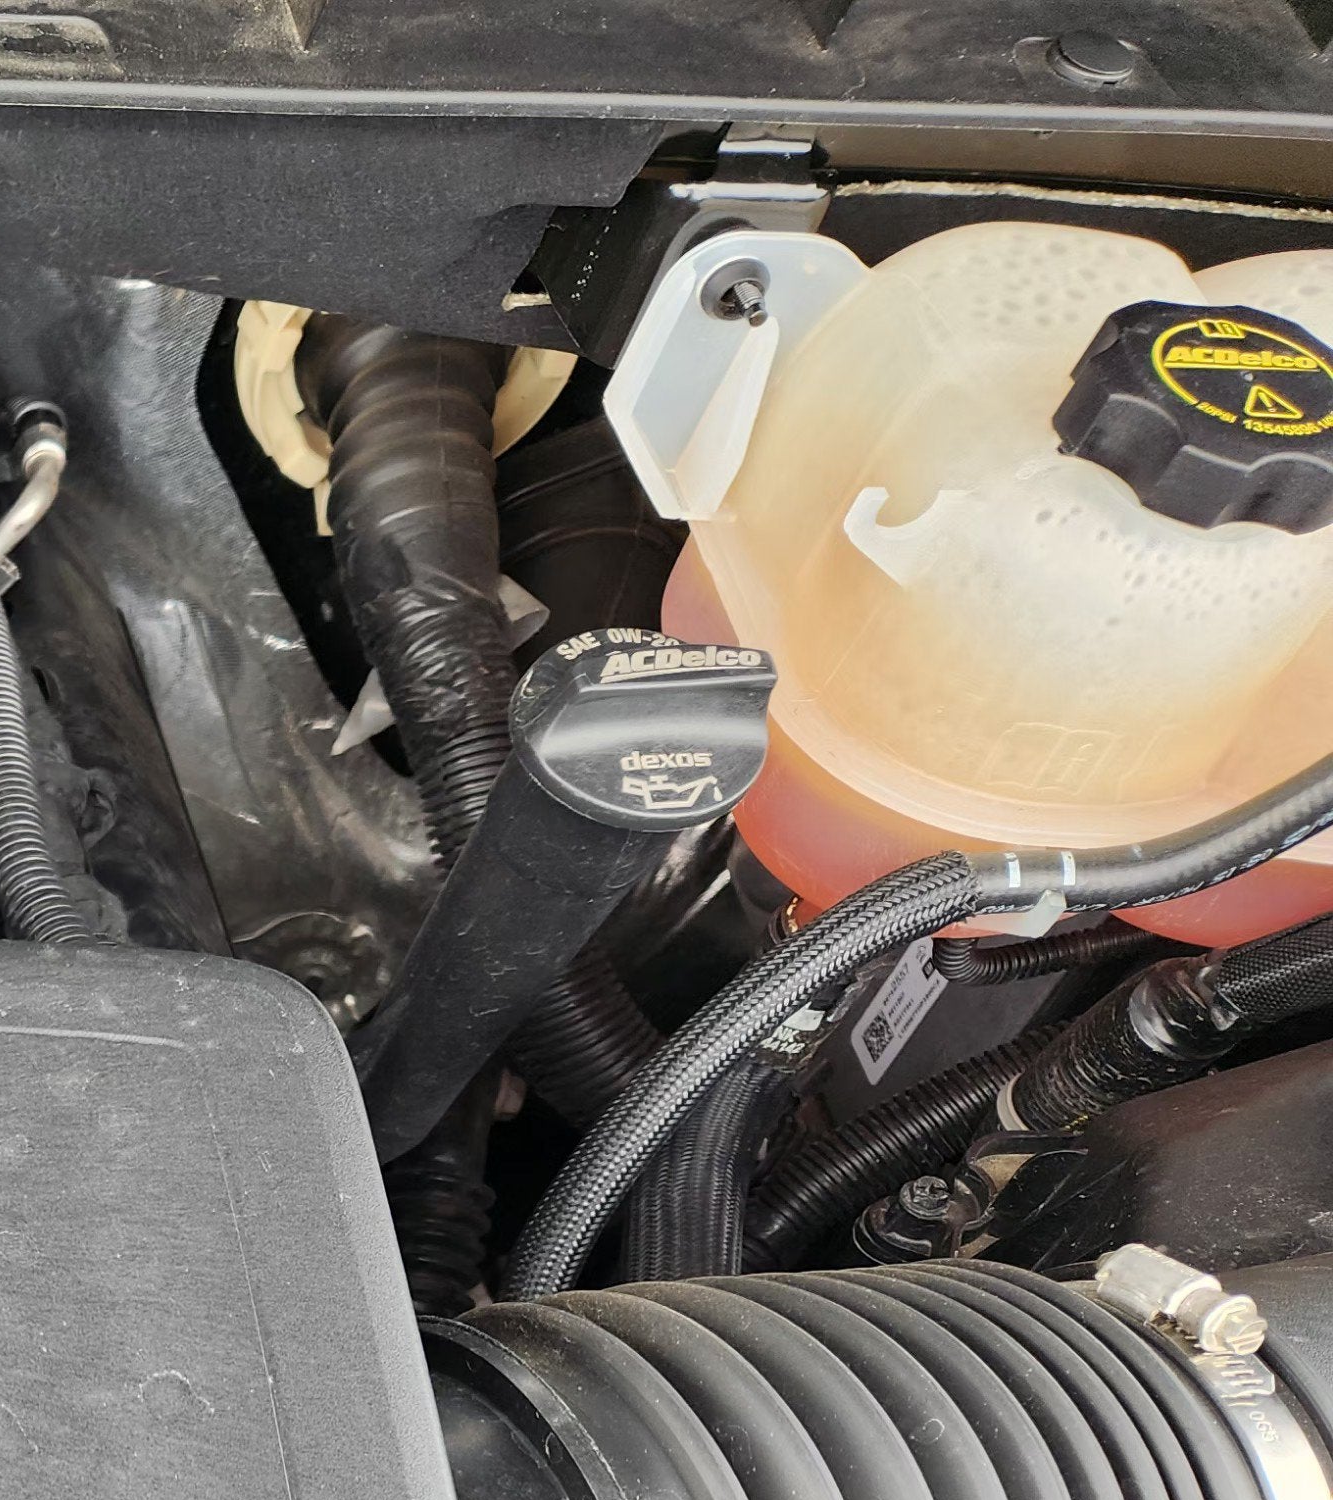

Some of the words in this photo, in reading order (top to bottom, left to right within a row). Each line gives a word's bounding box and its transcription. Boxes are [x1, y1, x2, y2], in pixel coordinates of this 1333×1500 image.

[1164, 345, 1319, 369] ACDelco
[556, 631, 602, 661] SAE
[599, 645, 763, 679] ACDelco
[619, 750, 713, 772] dexos
